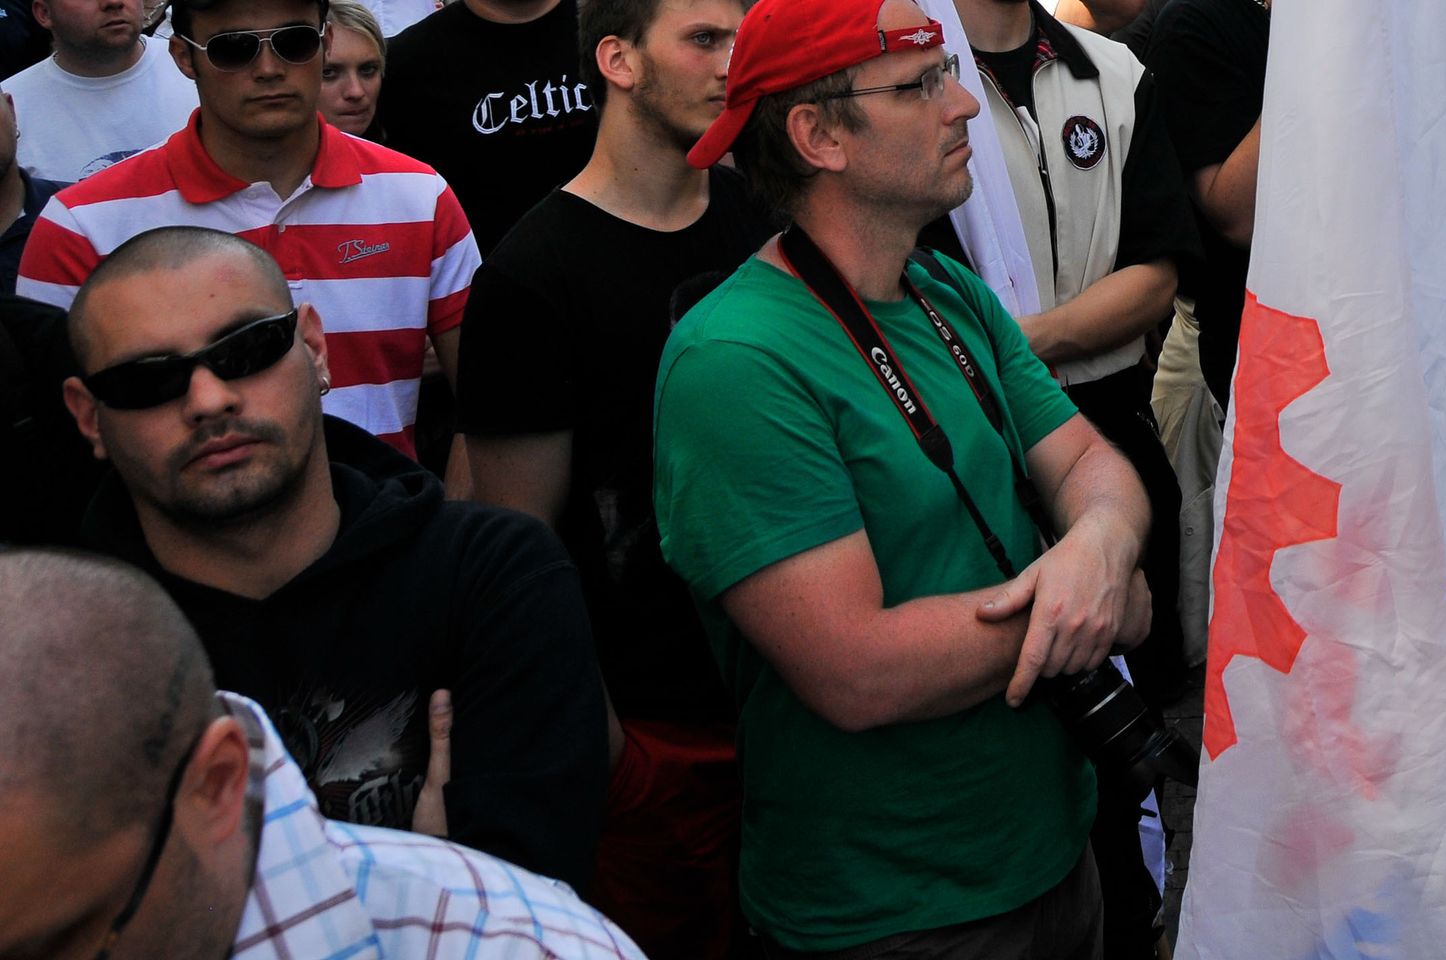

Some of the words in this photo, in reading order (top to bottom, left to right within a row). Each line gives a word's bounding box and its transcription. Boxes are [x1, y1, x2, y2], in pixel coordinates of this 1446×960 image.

[472, 74, 592, 135] Celtic
[871, 346, 917, 415] Canon
[952, 344, 975, 378] 60D
